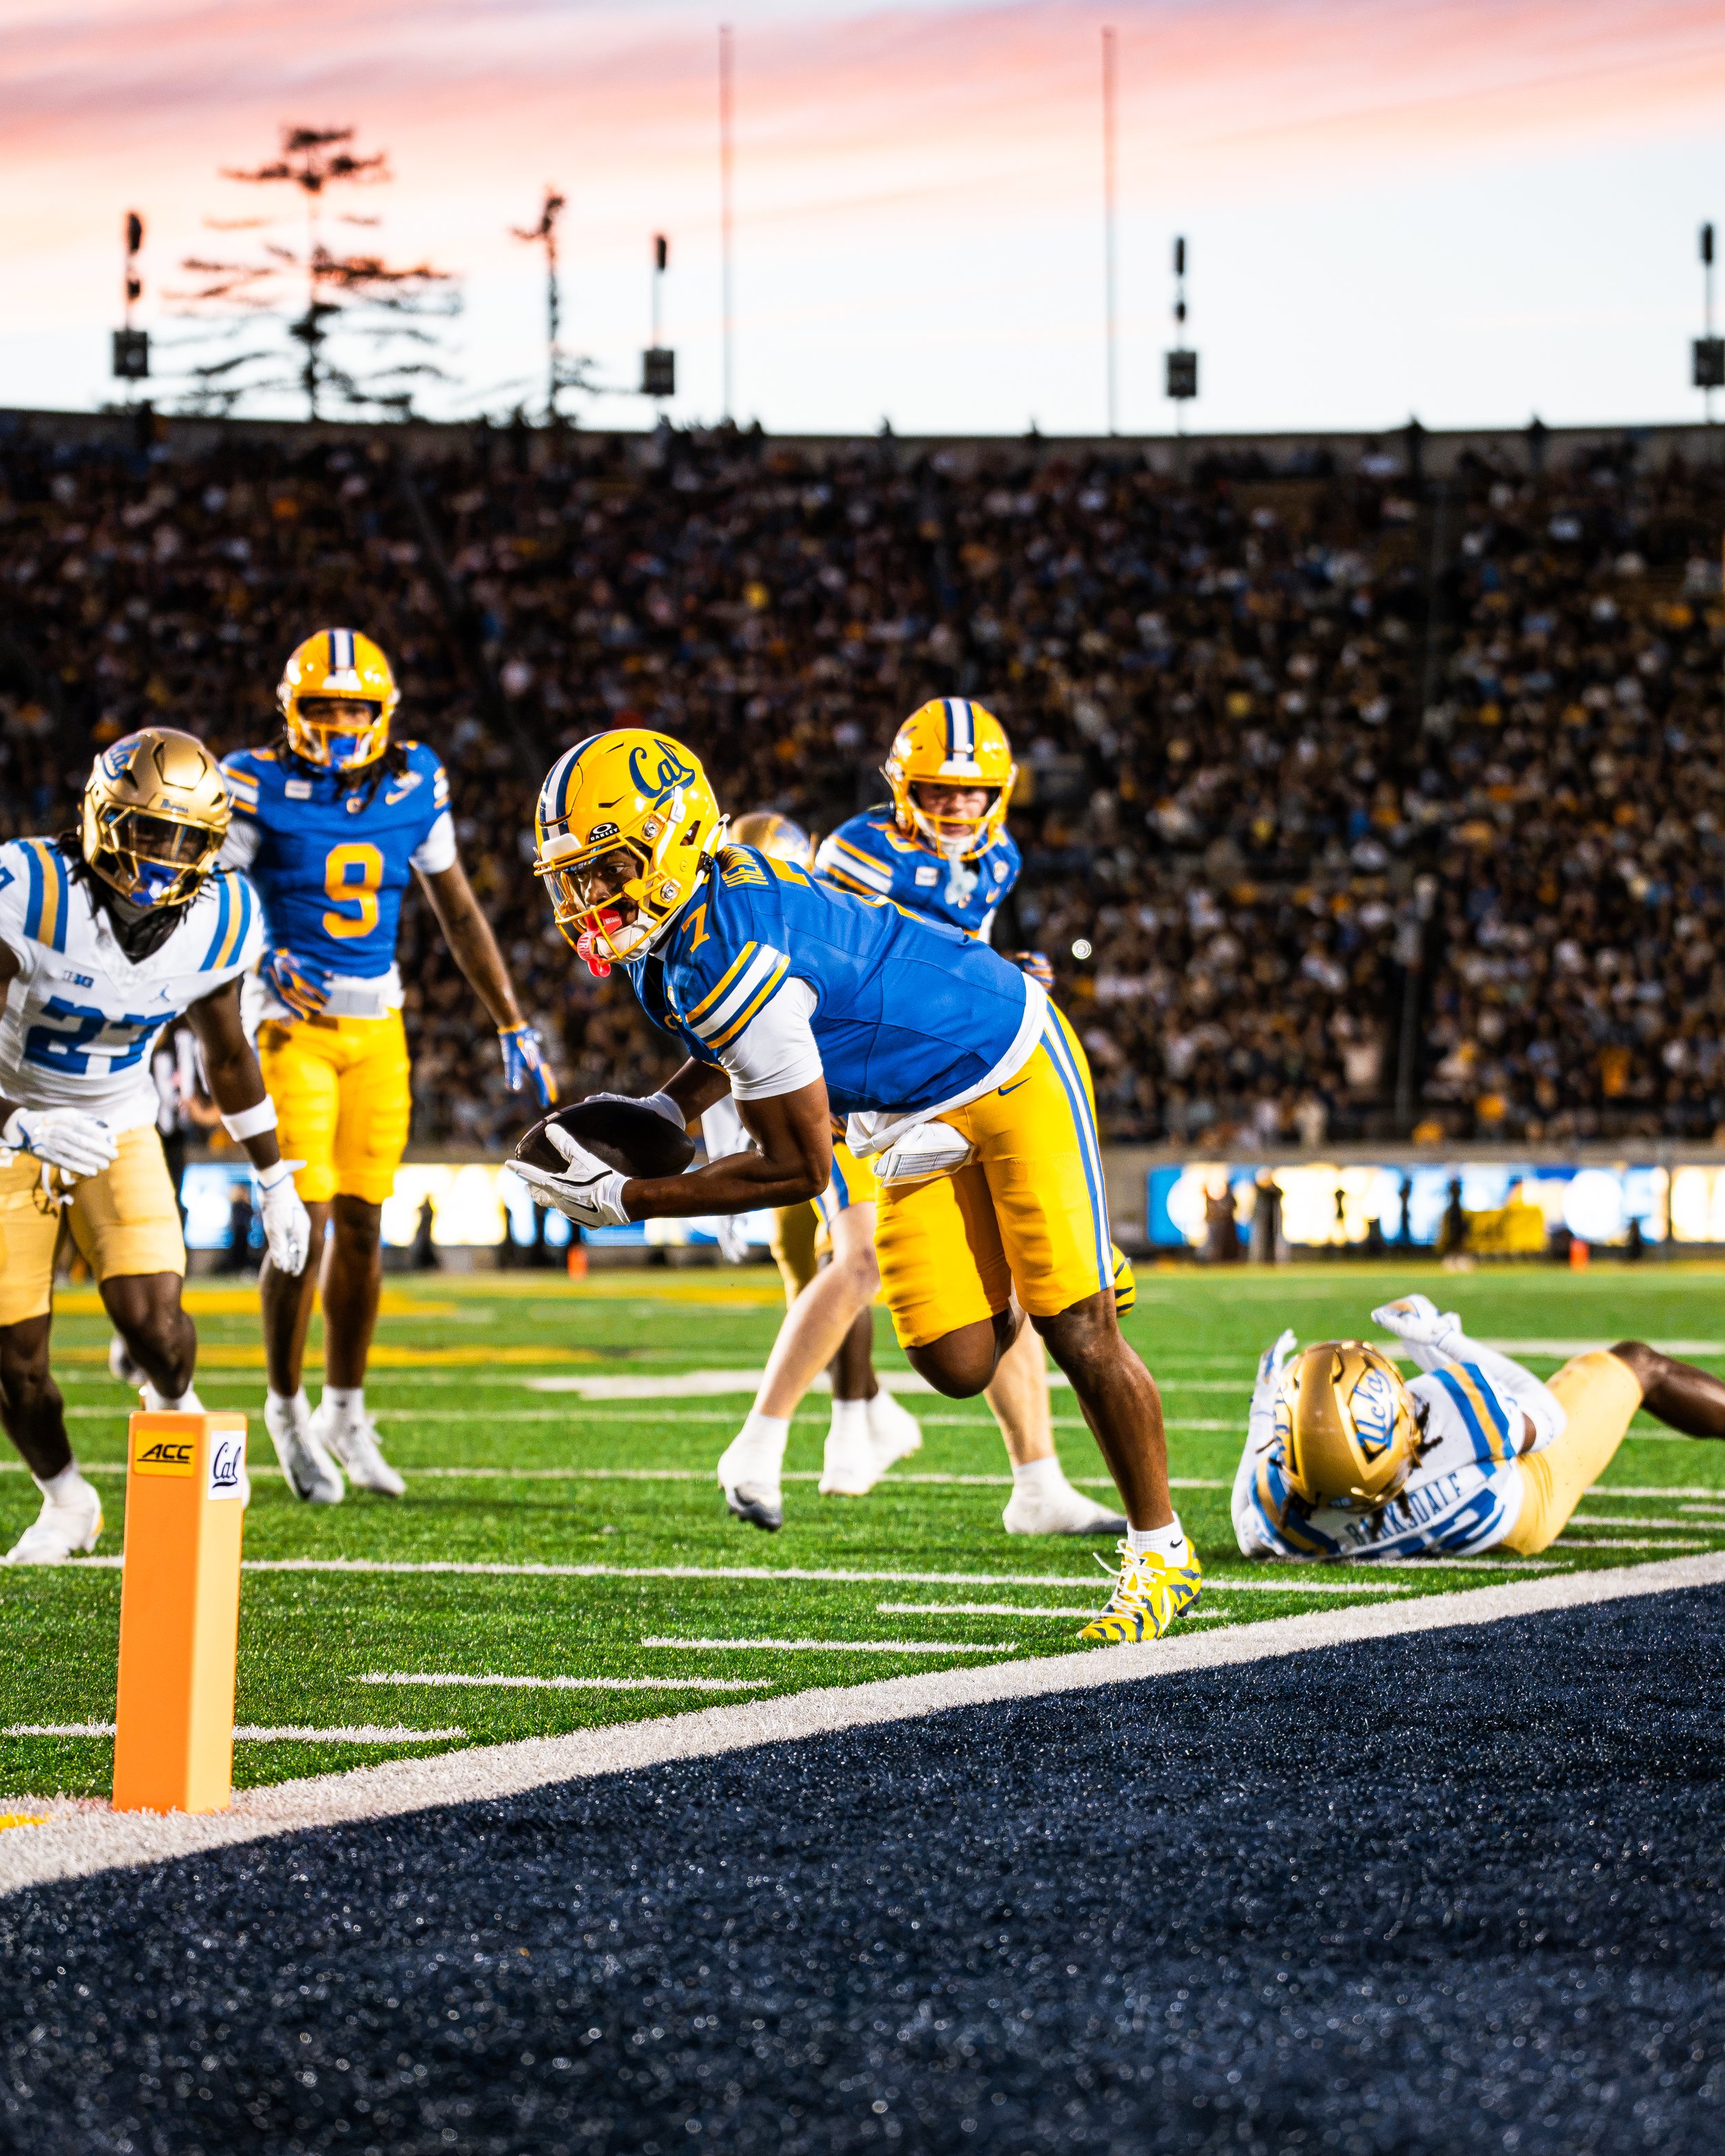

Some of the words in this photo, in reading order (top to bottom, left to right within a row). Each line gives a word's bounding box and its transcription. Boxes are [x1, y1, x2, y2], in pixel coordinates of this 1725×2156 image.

[629, 738, 696, 811] Cal
[590, 827, 618, 841] OAKLEY
[322, 842, 384, 939] 9
[681, 902, 710, 953] 7
[24, 994, 177, 1075] 27
[141, 1443, 195, 1460] ACC
[213, 1441, 241, 1488] Cal
